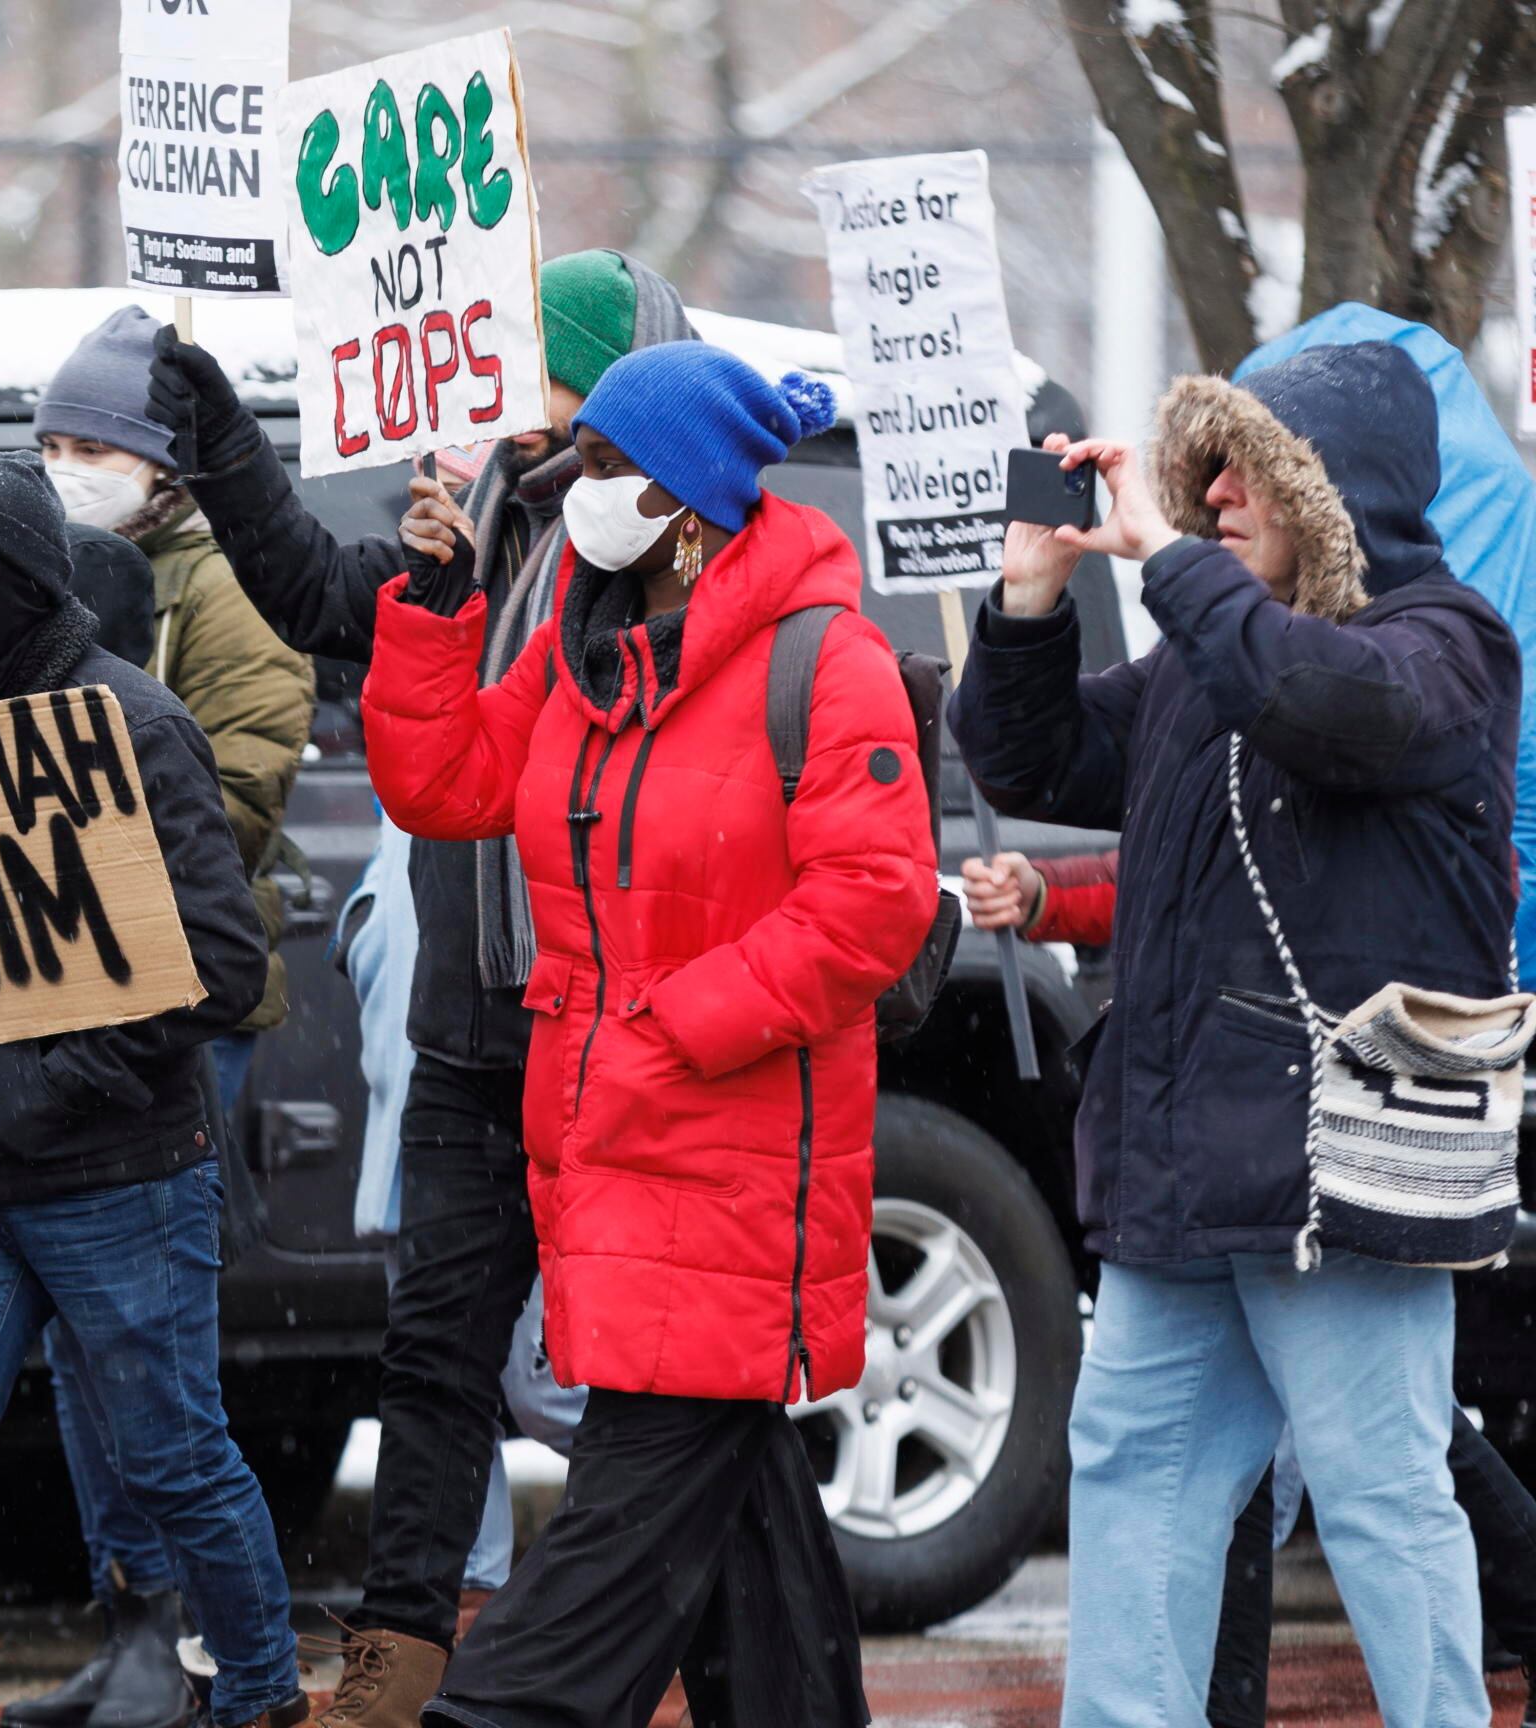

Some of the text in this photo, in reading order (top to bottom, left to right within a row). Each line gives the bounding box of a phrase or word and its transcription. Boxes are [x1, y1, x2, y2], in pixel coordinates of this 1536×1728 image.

[128, 76, 263, 135] TERRENCE
[127, 139, 260, 198] COLEMAN
[296, 70, 513, 256] CARE
[836, 178, 959, 231] Justice for
[143, 233, 161, 261] Party
[162, 236, 175, 258] for
[176, 238, 223, 263] Socialism
[226, 242, 255, 264] and
[371, 235, 448, 317] NOT
[205, 271, 258, 289] PSLweb.org
[867, 250, 940, 306] Angie
[870, 312, 962, 363] Barros!
[332, 299, 503, 458] COPS
[867, 387, 999, 435] and Junior
